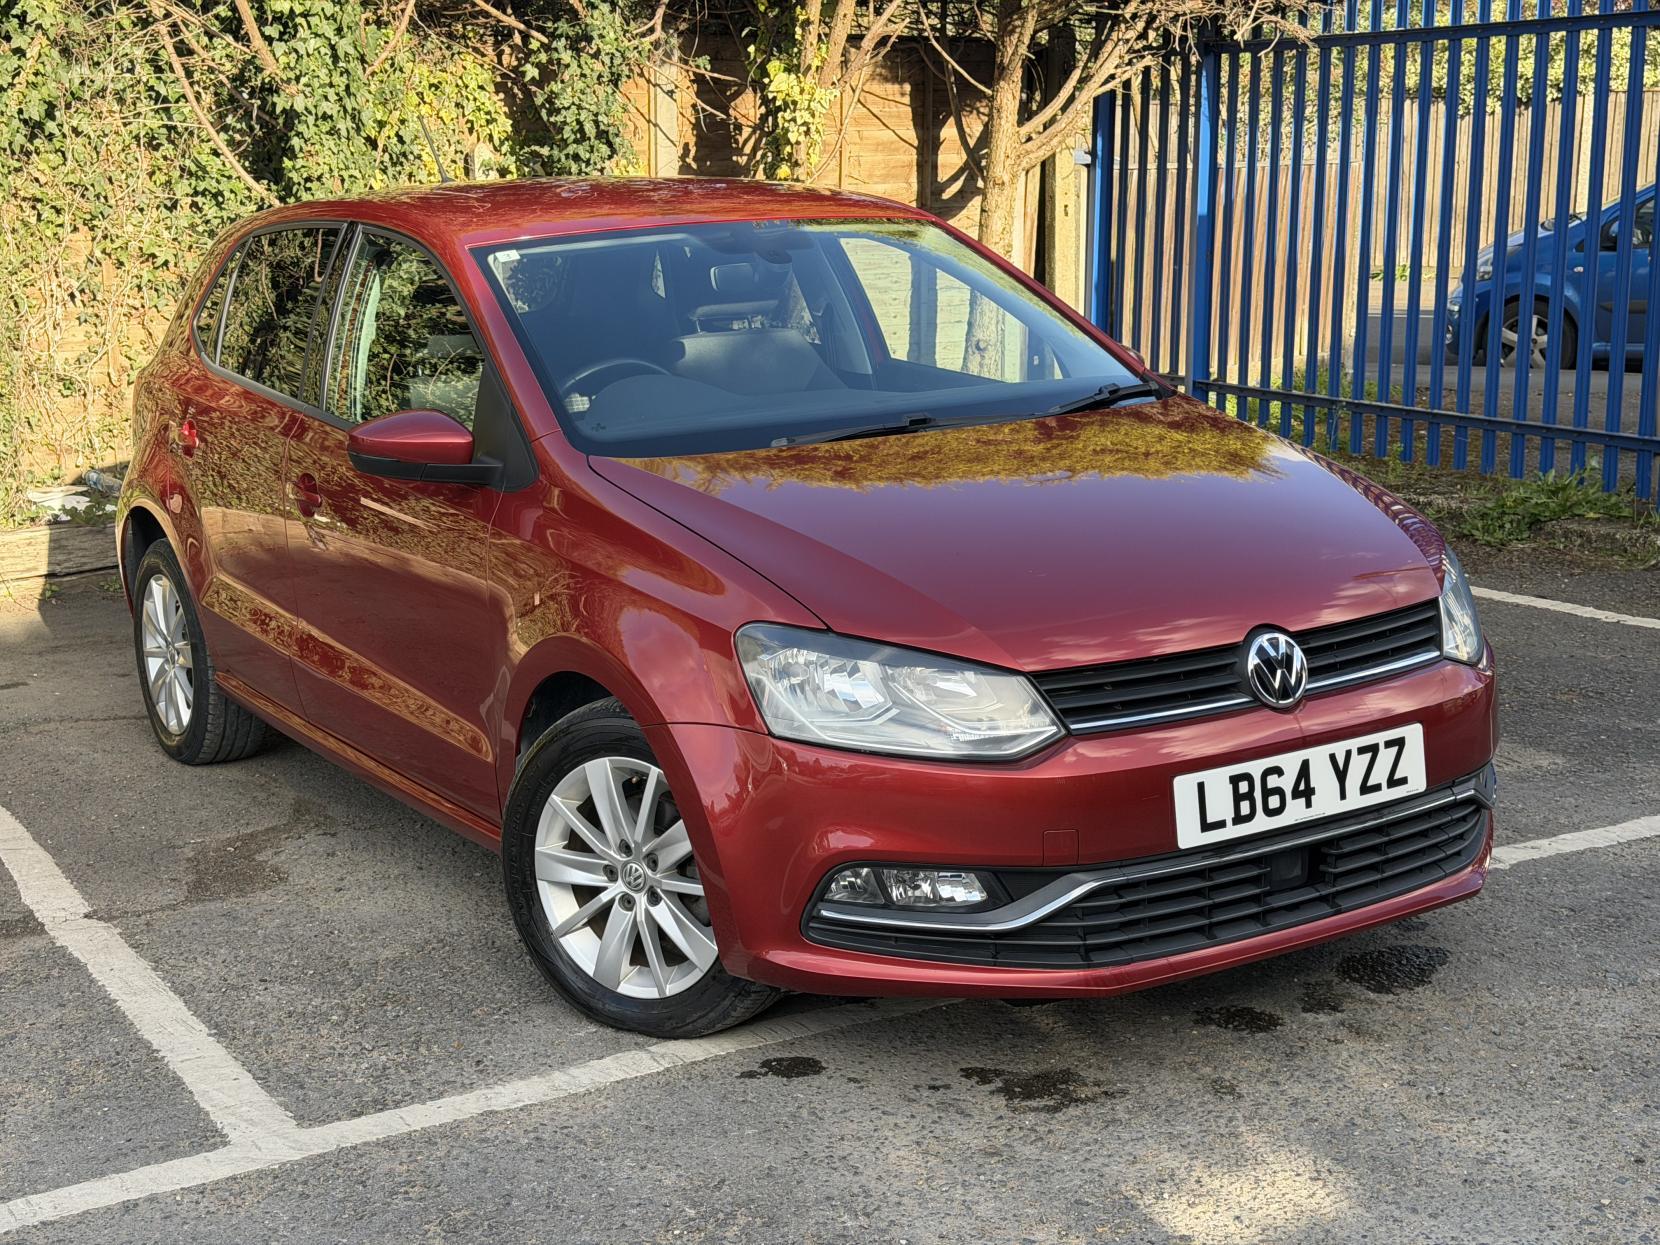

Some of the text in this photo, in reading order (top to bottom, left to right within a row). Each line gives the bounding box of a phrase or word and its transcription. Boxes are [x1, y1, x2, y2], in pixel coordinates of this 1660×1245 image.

[1250, 635, 1306, 705] VW
[1197, 736, 1409, 834] LB64 YZZ
